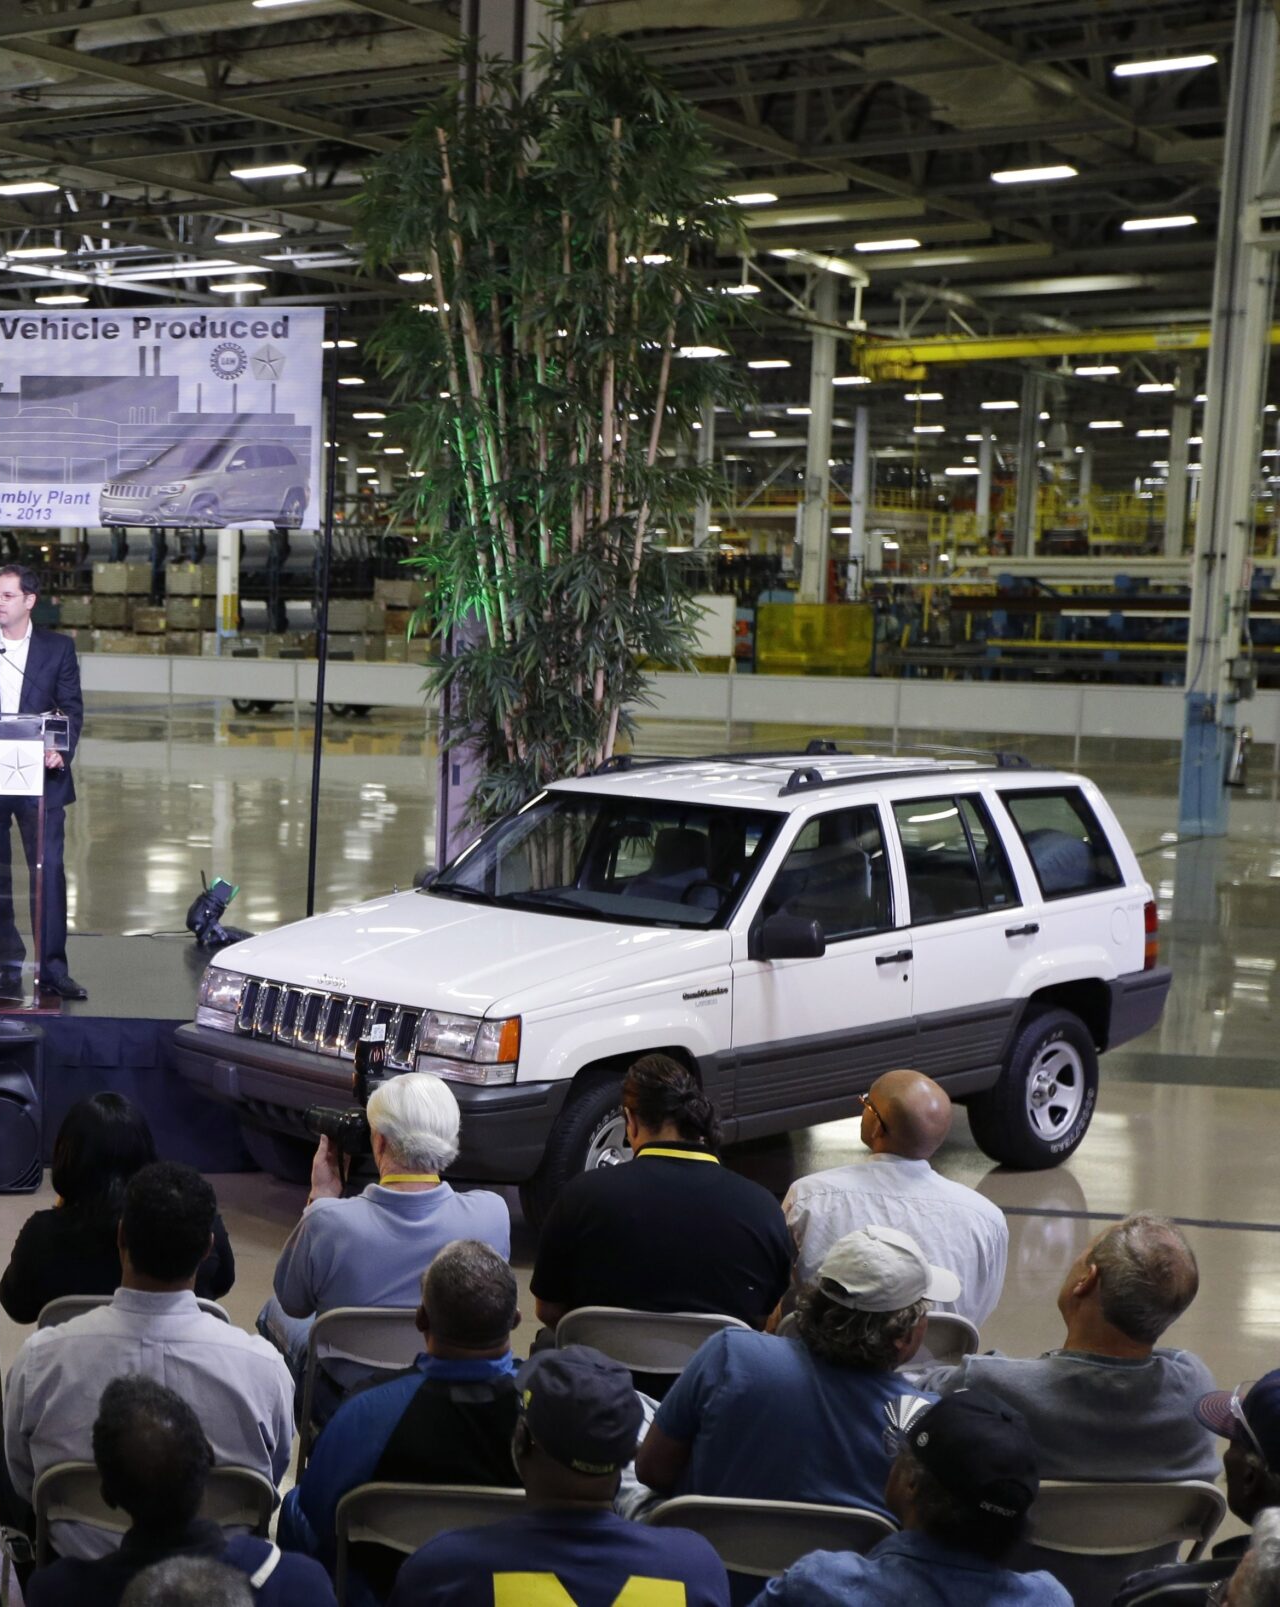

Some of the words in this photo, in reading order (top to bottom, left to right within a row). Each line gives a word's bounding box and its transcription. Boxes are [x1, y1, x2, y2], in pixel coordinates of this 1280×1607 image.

[133, 315, 289, 340] Produced
[47, 490, 91, 505] Plant
[16, 508, 52, 520] 2013
